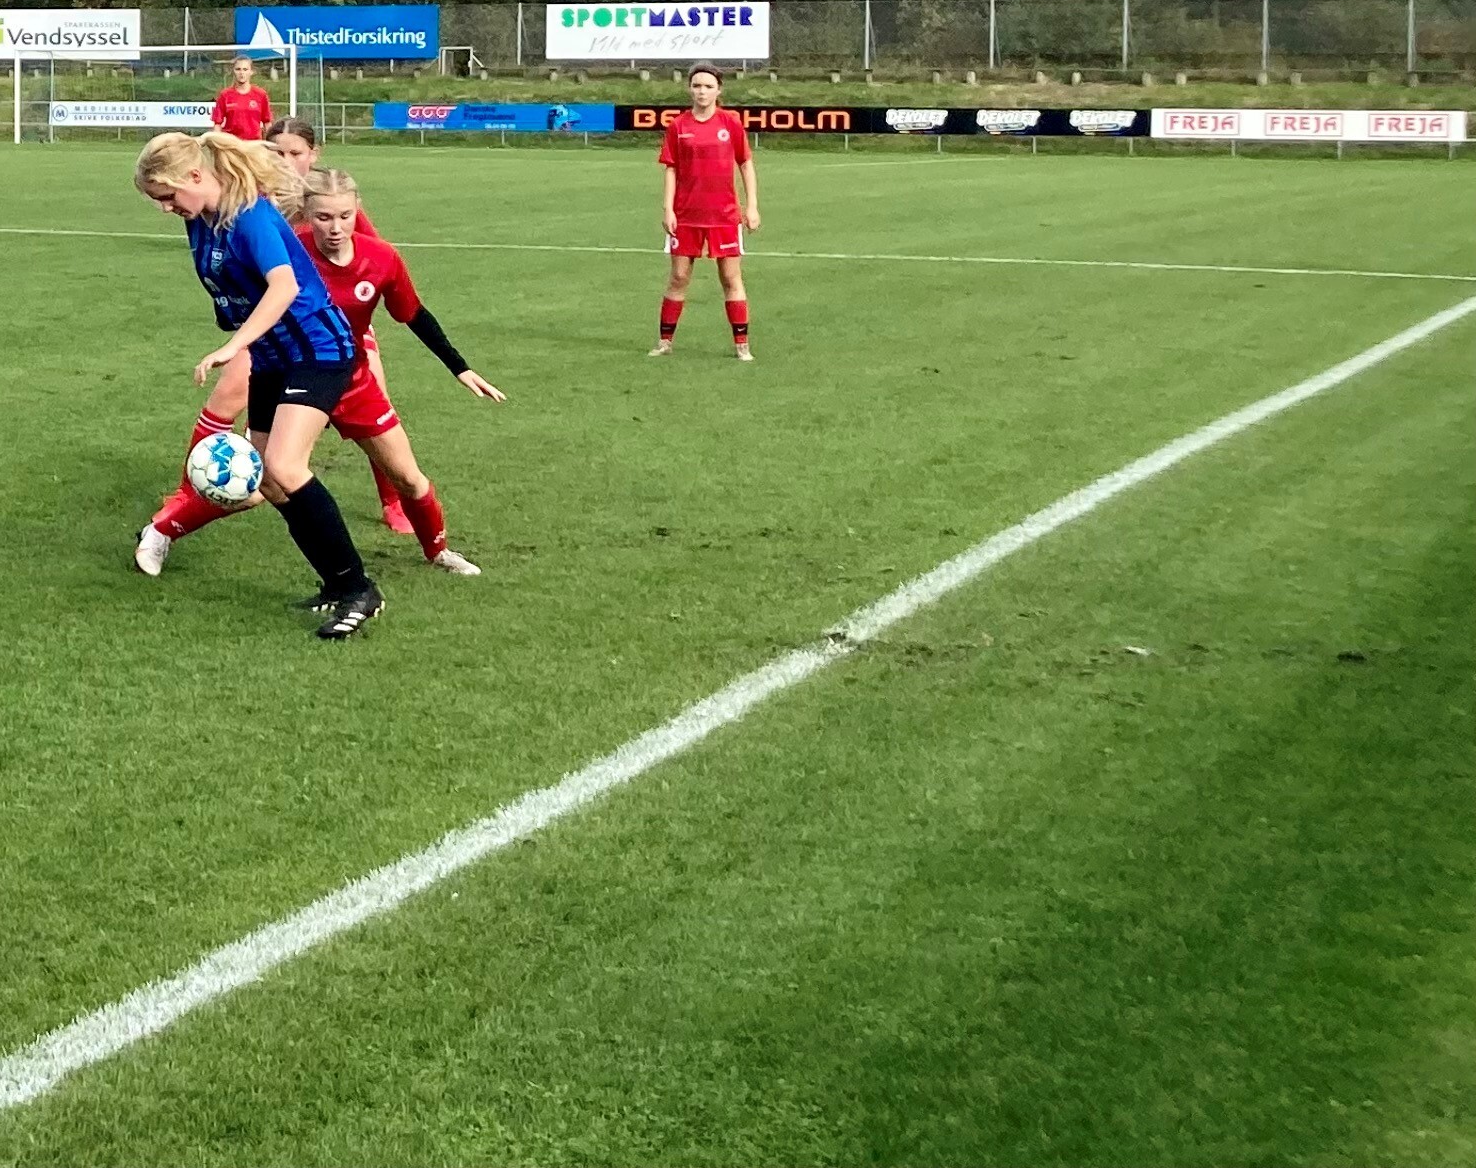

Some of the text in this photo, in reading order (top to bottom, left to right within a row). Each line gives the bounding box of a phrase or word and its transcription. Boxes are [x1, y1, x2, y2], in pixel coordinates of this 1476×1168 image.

[64, 21, 121, 29] SPAREKASSEN
[561, 6, 753, 28] SPORTMASTER
[7, 27, 129, 48] Vendsyssel
[286, 27, 427, 49] ThistedForsikring
[629, 31, 663, 49] med
[671, 29, 725, 52] sport
[633, 108, 851, 130] BEHOLM
[1169, 115, 1236, 130] FREJA
[1269, 116, 1338, 133] FREJA
[1373, 117, 1444, 134] FREJA
